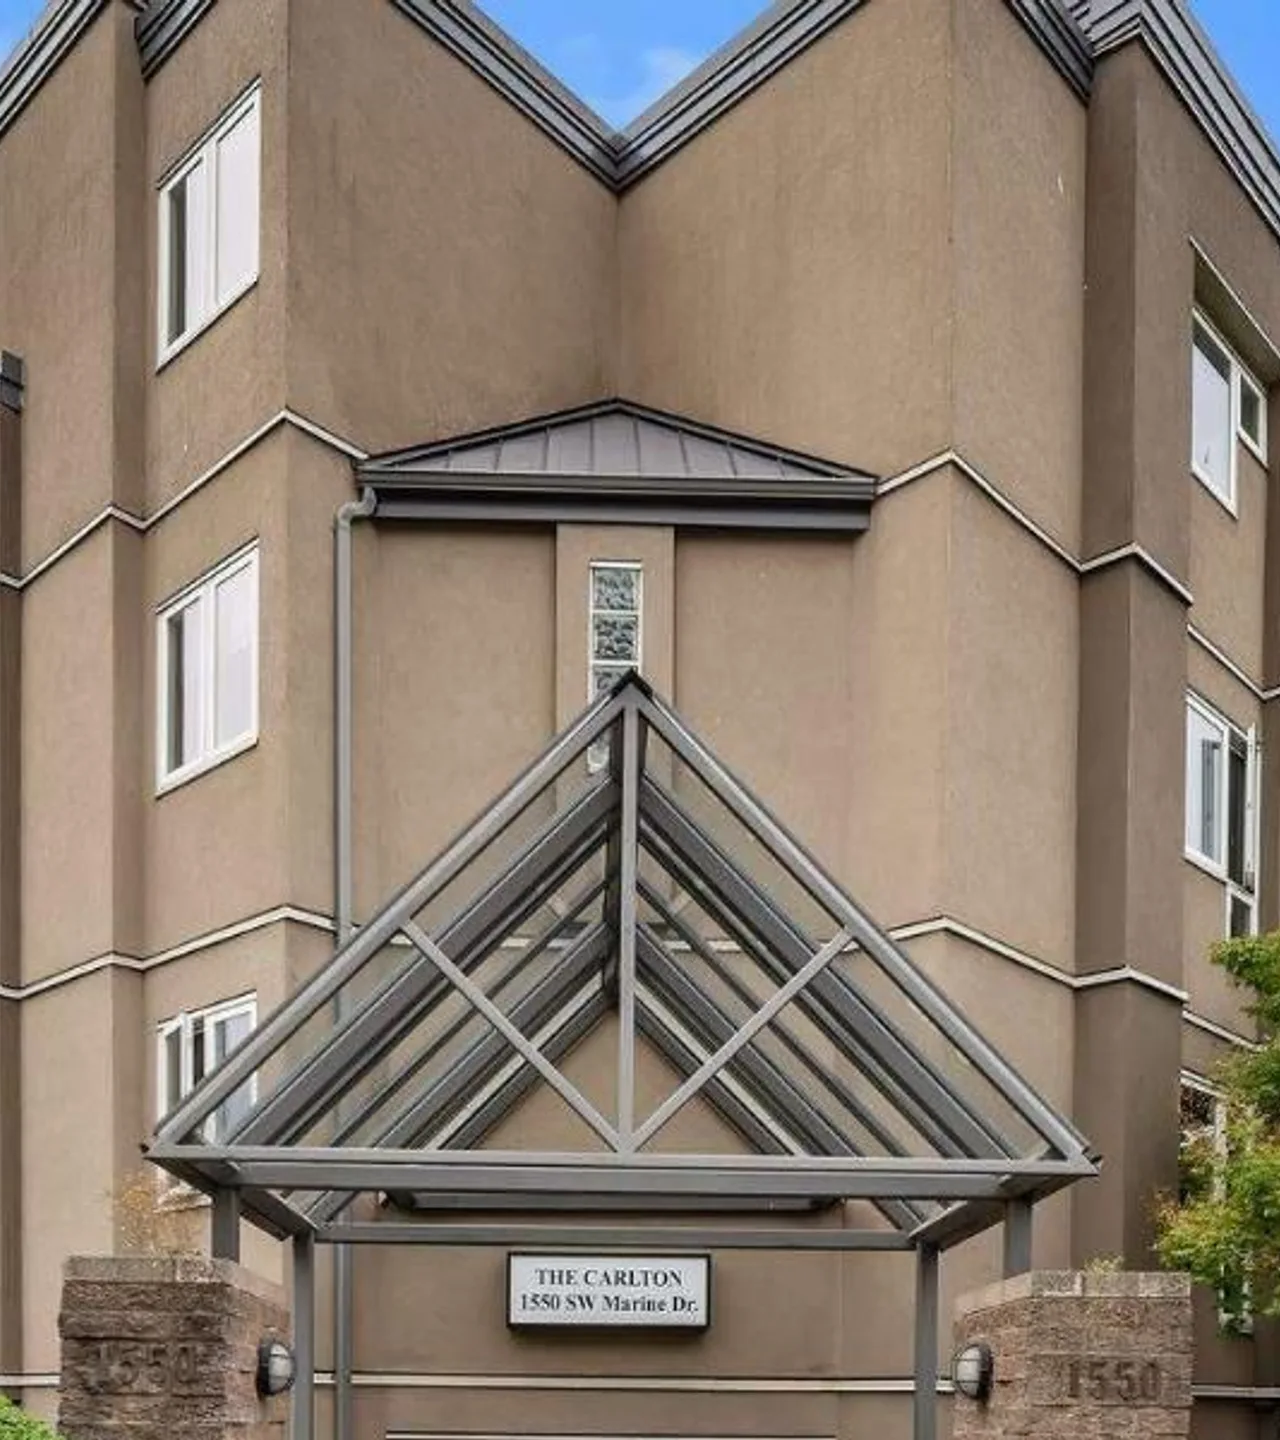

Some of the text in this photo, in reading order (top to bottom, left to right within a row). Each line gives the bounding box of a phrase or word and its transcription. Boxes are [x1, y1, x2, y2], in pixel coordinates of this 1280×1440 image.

[535, 1269, 683, 1288] THE CARLTON
[521, 1294, 700, 1313] 1550 SW Marine Dr.
[1067, 1361, 1162, 1401] 1550
